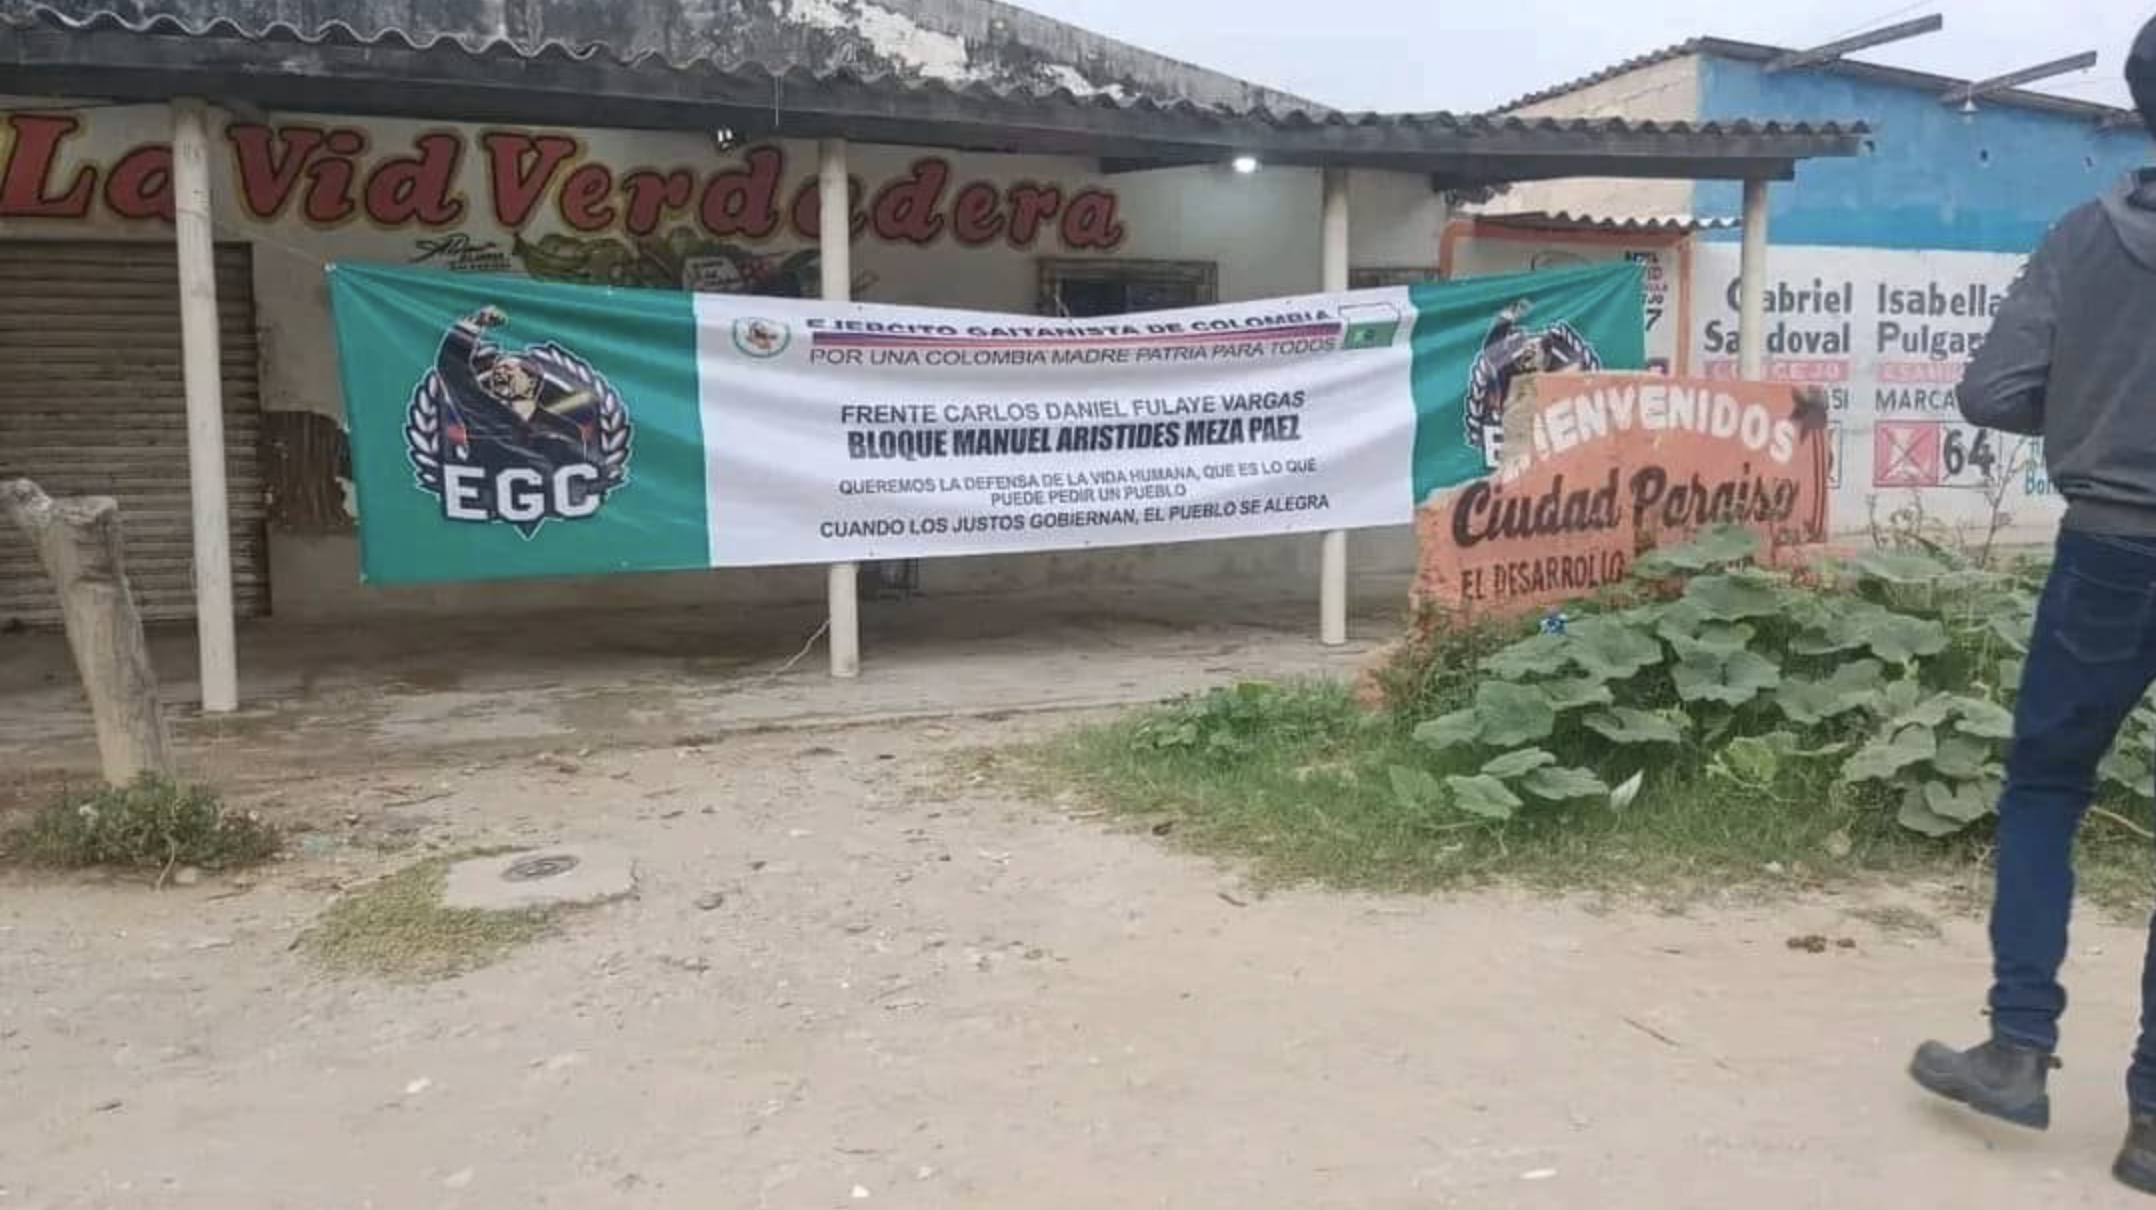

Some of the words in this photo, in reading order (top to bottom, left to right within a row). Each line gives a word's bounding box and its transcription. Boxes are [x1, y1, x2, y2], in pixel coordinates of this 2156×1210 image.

[0, 114, 174, 221] La
[226, 122, 468, 225] Vid
[482, 132, 1123, 250] Verdadera
[1149, 320, 1183, 334] DE
[1703, 319, 1850, 354] Sadoval
[809, 349, 863, 366] POR
[871, 349, 920, 366] UNA
[925, 349, 1047, 366] COLOMBIA
[1050, 348, 1129, 365] MADRE
[1135, 346, 1208, 363] PATRIA
[1212, 340, 1266, 359] PARA
[1270, 337, 1337, 355] TODOS
[841, 404, 938, 424] FRENTE
[943, 402, 1041, 423] CARLOS
[1045, 399, 1127, 421] DANIEL
[1133, 395, 1216, 416] FULAYE
[1220, 390, 1306, 412] VARGAS
[1874, 388, 1956, 412] MARCA
[848, 429, 947, 461] BLOQUE
[952, 427, 1051, 457] MANUEL
[1055, 421, 1180, 453] ARISTIDES
[1184, 417, 1244, 447] MEZA
[1248, 414, 1301, 441] PAEZ
[1943, 428, 1996, 477] 64
[443, 463, 600, 522] EGC
[839, 477, 937, 496] QUEREMOS
[940, 477, 961, 492] LA
[964, 474, 1041, 491] DEFENSA
[1043, 473, 1065, 488] DE
[1067, 471, 1089, 487] LA
[1090, 469, 1129, 485] VIDA
[1130, 465, 1200, 483] HUMANA,
[1203, 463, 1237, 480] QUE
[1239, 462, 1260, 477] ES
[1262, 460, 1283, 475] LO
[1286, 457, 1317, 473] QUE
[991, 490, 1044, 507] PUEDE
[1050, 487, 1094, 505] PEDIR
[1099, 486, 1121, 501] UN
[1123, 483, 1187, 500] PUEBLO
[820, 519, 905, 539] CUANDO
[909, 517, 948, 536] LOS
[952, 514, 1025, 534] JUSTOS
[1029, 508, 1139, 529] GOBIERNAN,
[1143, 506, 1165, 523] EL
[1169, 501, 1237, 521] PUEBLO
[1240, 499, 1261, 515] SE
[1264, 494, 1330, 512] ALEGRA
[1452, 467, 1621, 548] Ciudad
[1629, 461, 1799, 529] Paraiso
[1461, 568, 1487, 600] EL
[1493, 549, 1626, 597] DESARROLLO
